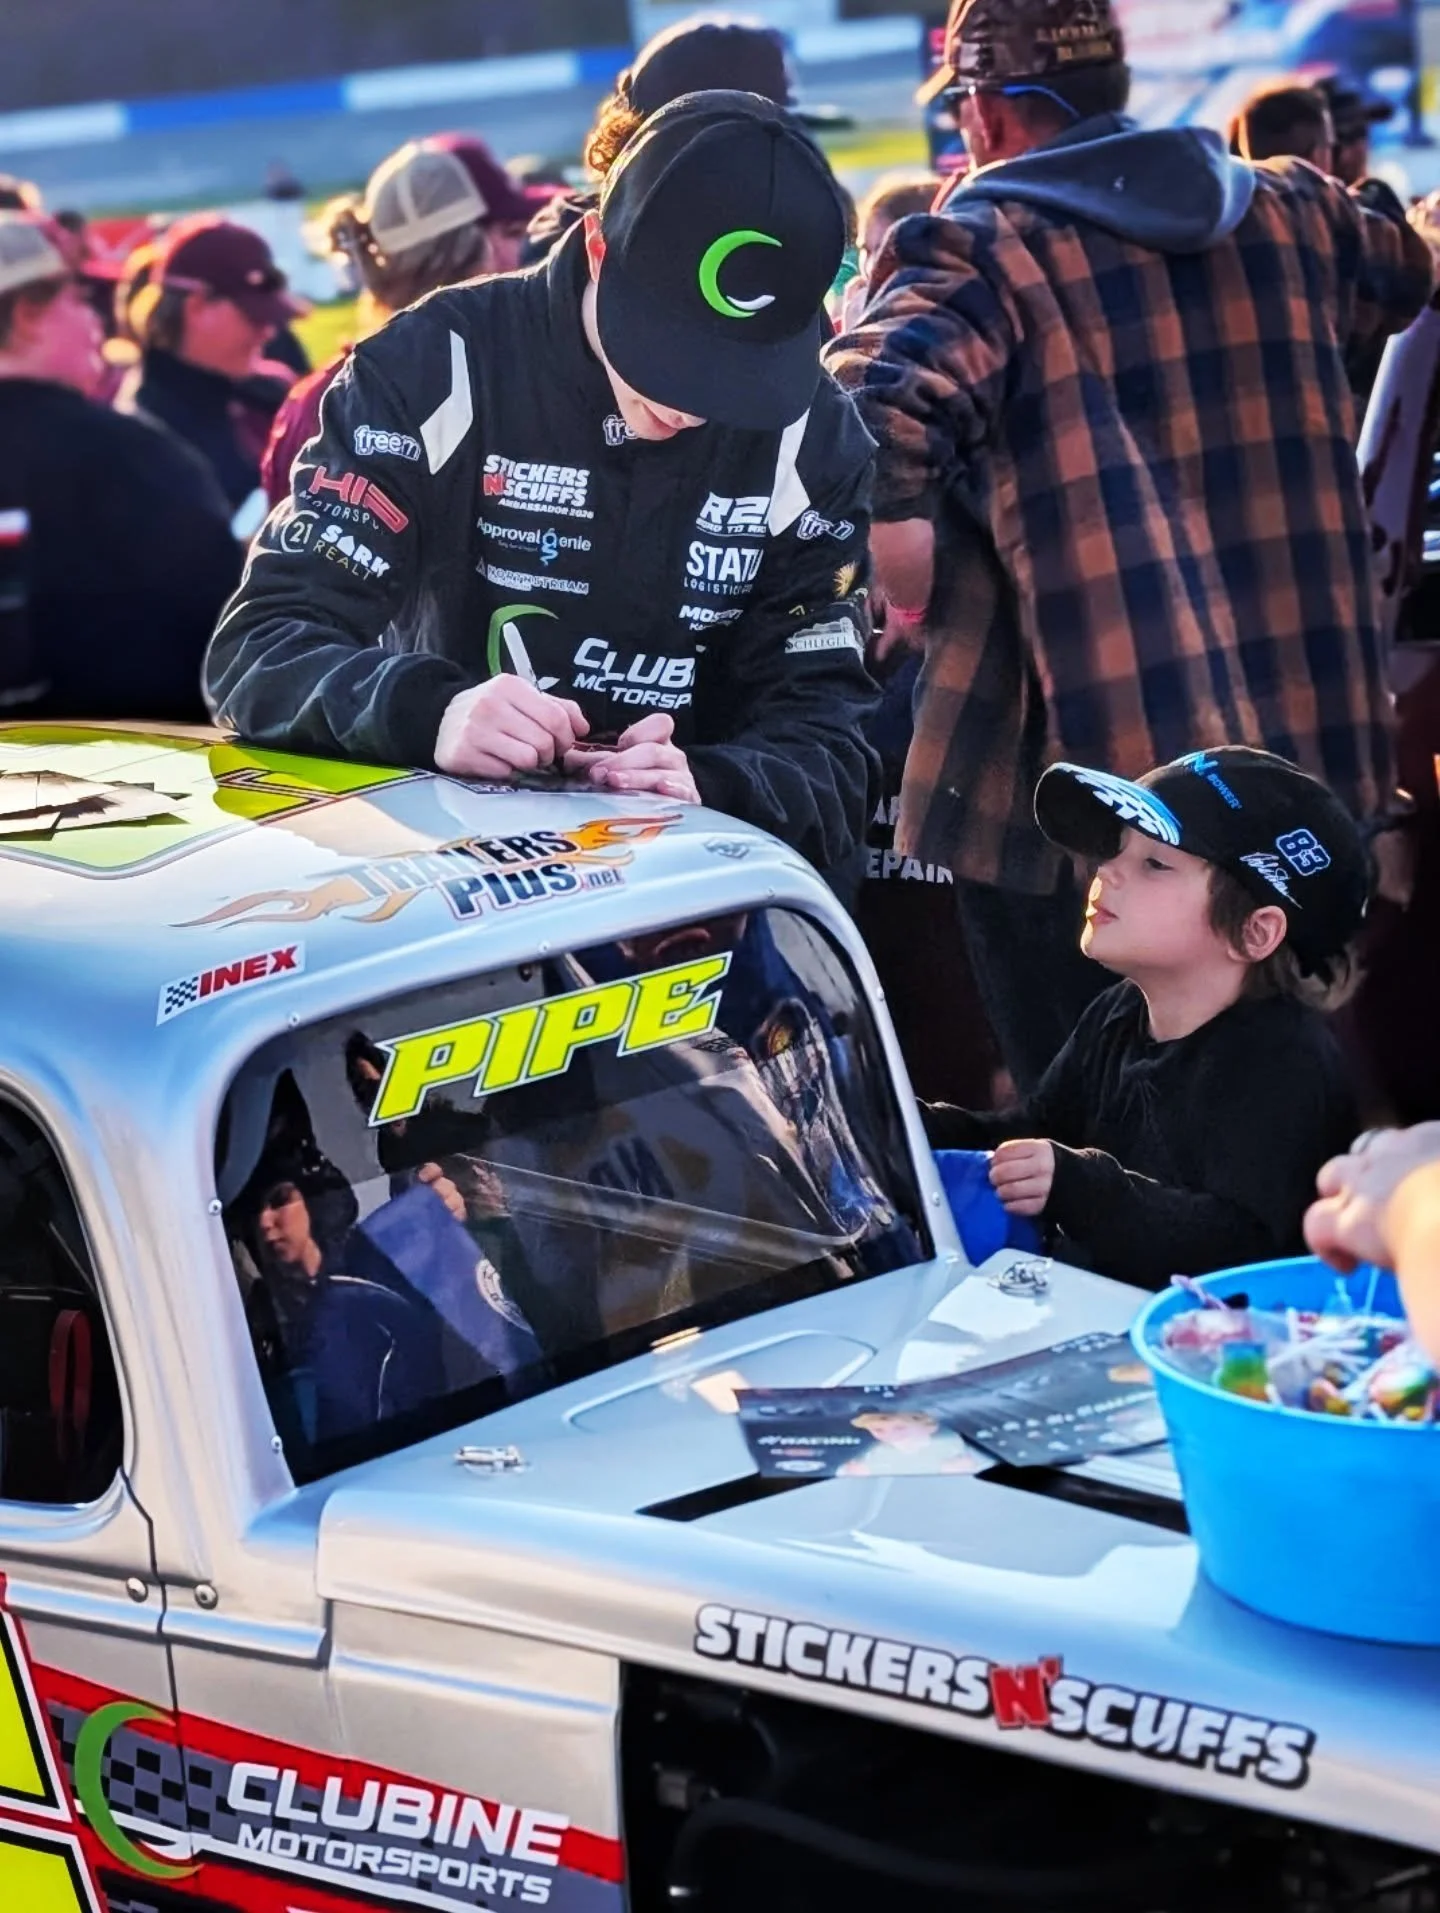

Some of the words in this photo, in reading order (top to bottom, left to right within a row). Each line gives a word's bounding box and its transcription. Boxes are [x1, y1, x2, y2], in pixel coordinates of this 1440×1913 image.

[483, 454, 590, 488] STICKERS
[573, 637, 696, 689] CLUB
[200, 945, 298, 998] INEX
[369, 951, 734, 1128] PIPE
[695, 1603, 995, 1718] STICKERS
[1047, 1675, 1317, 1790] SCUFFS
[227, 1762, 570, 1867] CLUBINE
[236, 1823, 552, 1905] MOTORSPORTS
